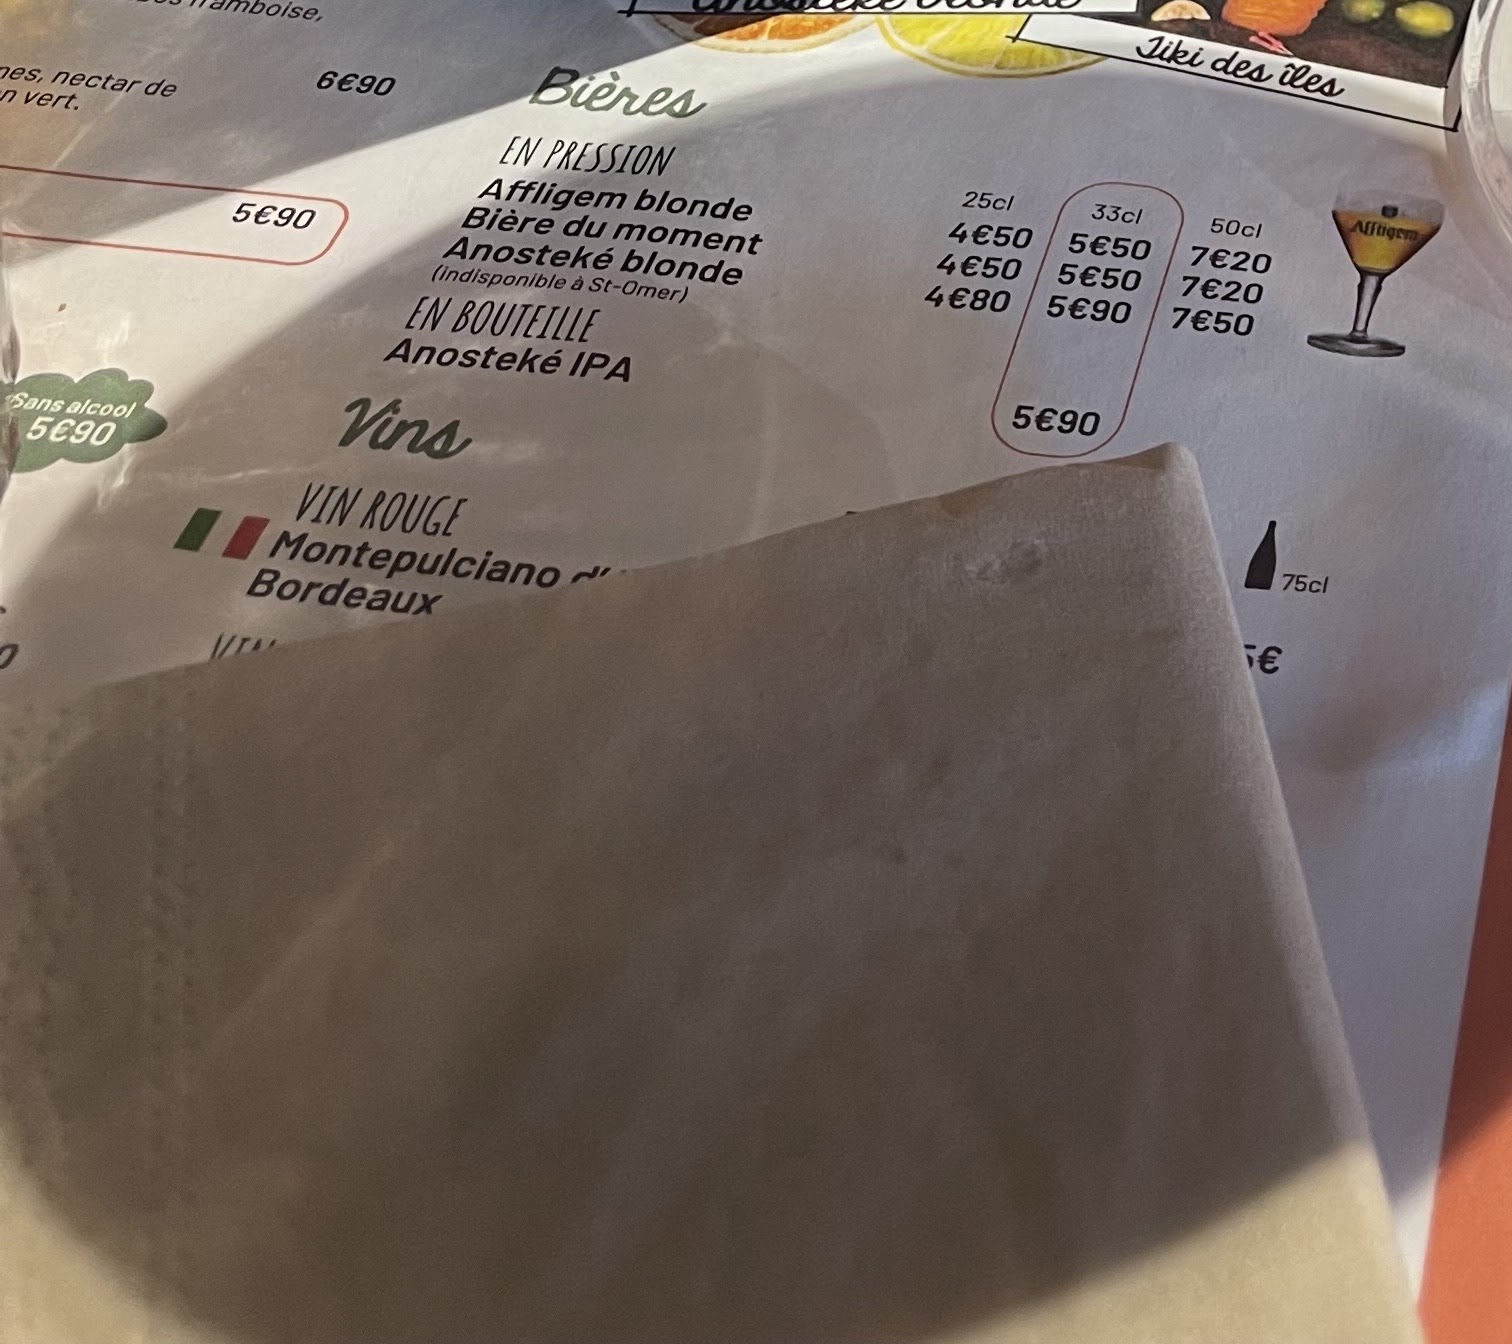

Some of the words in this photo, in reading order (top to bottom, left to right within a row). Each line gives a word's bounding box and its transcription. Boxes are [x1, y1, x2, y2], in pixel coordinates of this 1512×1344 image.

[51, 69, 143, 95] nectar
[144, 79, 177, 99] de
[316, 70, 396, 98] 6€90
[529, 66, 708, 119] Bières
[499, 135, 543, 167] EN
[543, 139, 677, 177] PRESSION
[961, 189, 1015, 213] 25cl
[1090, 202, 1145, 226] 33cl
[1209, 217, 1263, 240] 50cl
[232, 202, 318, 231] 5€90
[477, 177, 628, 212] Affligem
[634, 188, 754, 222] blonde
[948, 220, 1034, 250] 4€50
[1067, 232, 1152, 262] 5€50
[1189, 244, 1274, 276] 7€20
[431, 264, 568, 292] (indisponible
[460, 206, 556, 236] Bière
[562, 214, 608, 239] du
[612, 221, 764, 256] moment
[935, 253, 1024, 282] 4€50
[1056, 262, 1143, 292] 5€50
[1179, 275, 1265, 305] 7€20
[442, 236, 615, 271] Anosteké
[620, 249, 744, 286] blonde
[924, 285, 1012, 314] 4€80
[1046, 294, 1133, 325] 5€90
[1170, 307, 1256, 337] 7€50
[404, 295, 452, 332] EN
[451, 299, 601, 344] BOUTEILLE
[383, 337, 562, 376] Anosteké
[569, 350, 634, 383] IPA
[1010, 404, 1101, 437] 5€90
[25, 415, 119, 448] 5€90
[338, 396, 474, 461] Vins
[296, 481, 363, 527] VIN
[360, 490, 468, 538] ROUGE
[268, 529, 562, 589] Montepulciano
[1281, 573, 1329, 595] 75cl
[246, 567, 444, 615] Bordeaux
